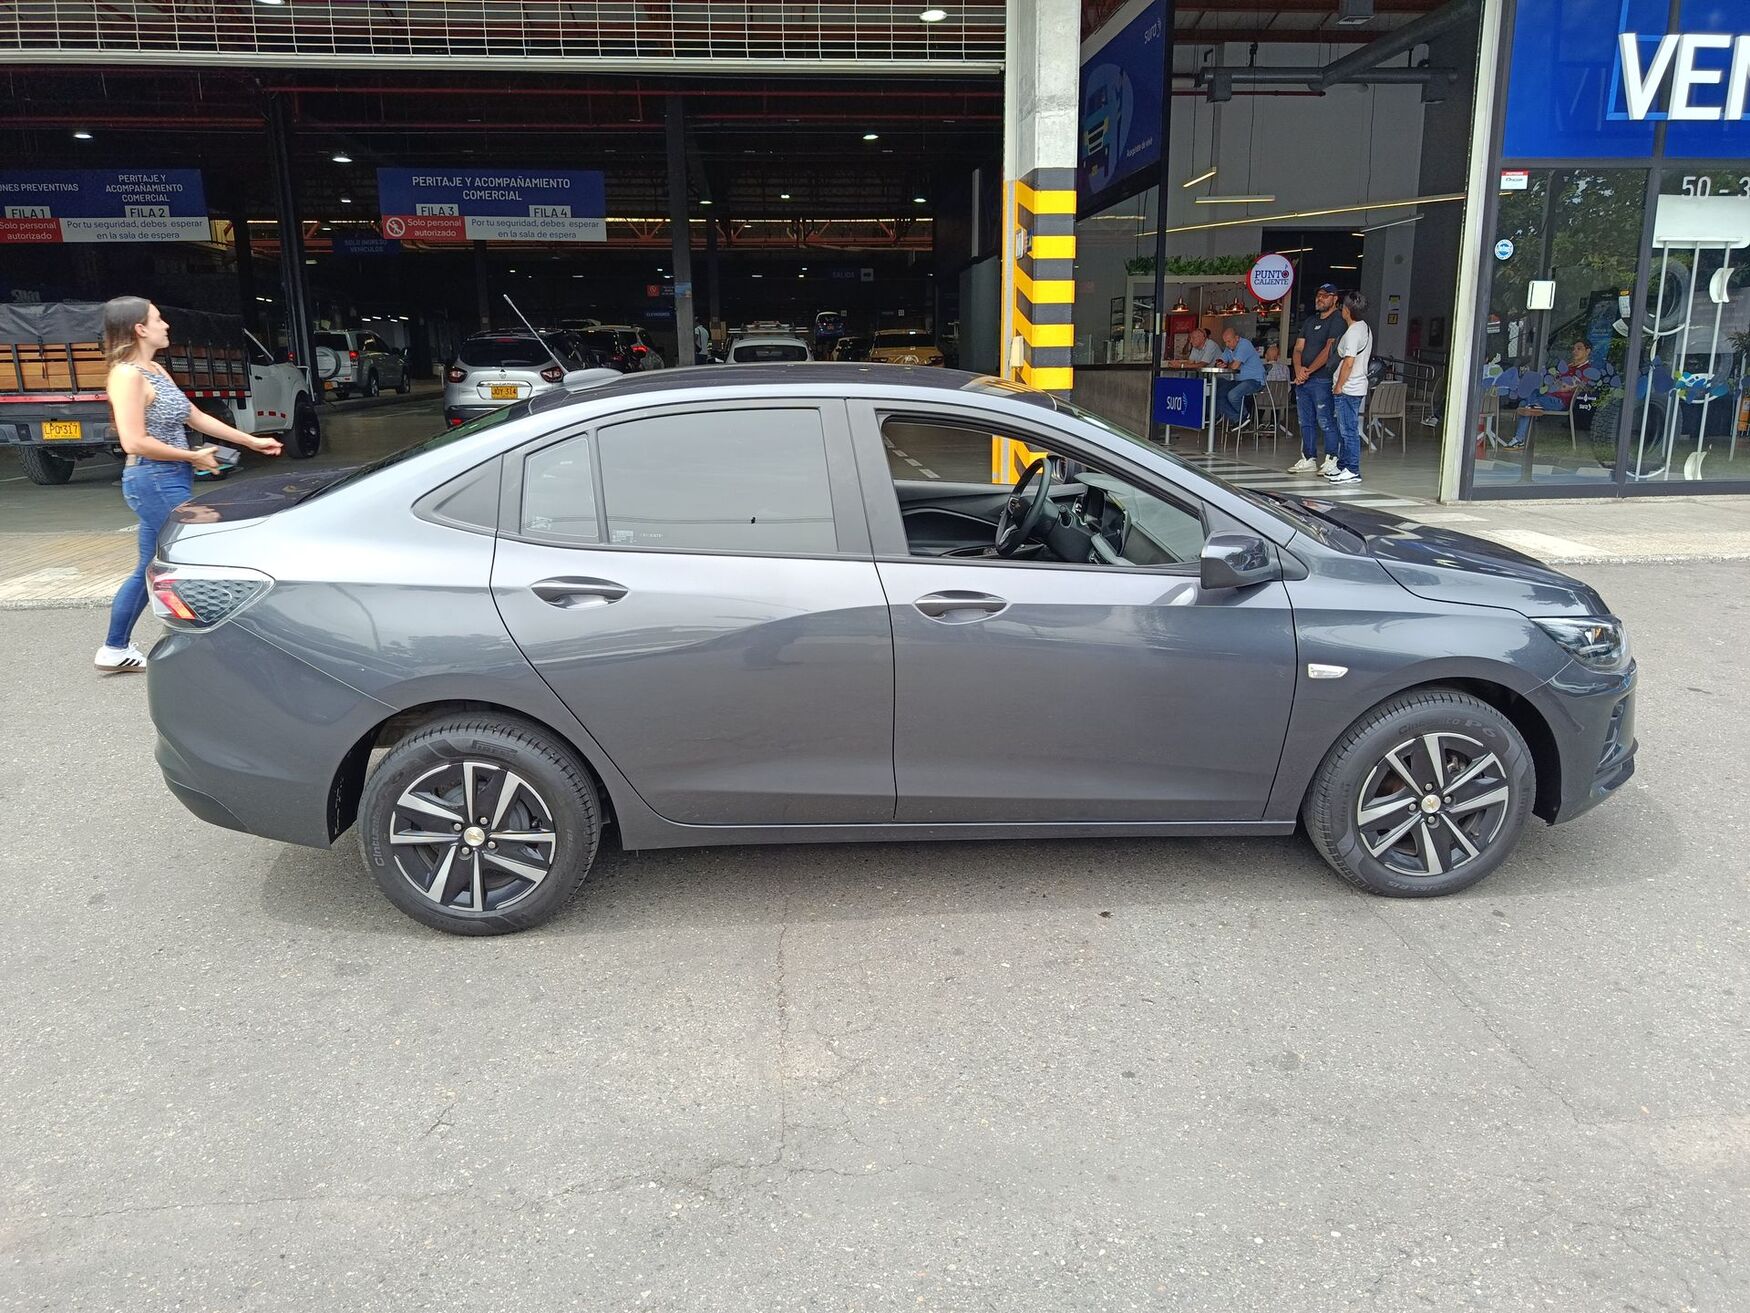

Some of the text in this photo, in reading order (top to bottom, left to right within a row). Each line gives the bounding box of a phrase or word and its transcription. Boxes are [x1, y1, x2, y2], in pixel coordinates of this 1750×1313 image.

[118, 174, 166, 183] PERITAJE Y
[412, 175, 570, 188] PERITAJE Y ACOMPAÑAMIENTO
[20, 183, 80, 192] PREVENTIVAS
[105, 182, 183, 192] ACOMPAÑAMIENTO
[1681, 176, 1712, 200] 50
[122, 194, 170, 202] COMERCIAL
[462, 190, 522, 200] COMERCIAL
[11, 208, 45, 218] FILA 1
[130, 208, 166, 218] FILA 2
[421, 206, 454, 216] FILA 3
[534, 208, 568, 218] FILA 4
[20, 222, 57, 232] personal
[66, 221, 82, 229] Por
[83, 221, 92, 229] tu
[140, 220, 167, 228] debes
[170, 221, 202, 229] esperar
[407, 218, 462, 228] Solo personal
[471, 218, 486, 226] Por
[540, 220, 566, 228] debes
[569, 222, 600, 230] esperar
[7, 232, 52, 240] autorizado
[96, 232, 108, 240] en
[110, 232, 117, 240] la
[119, 232, 136, 240] sala
[151, 232, 180, 240] espera
[510, 230, 518, 238] la
[519, 230, 535, 238] sala
[537, 230, 548, 238] de
[1255, 268, 1290, 280] PUNTO
[1166, 395, 1182, 411] sura
